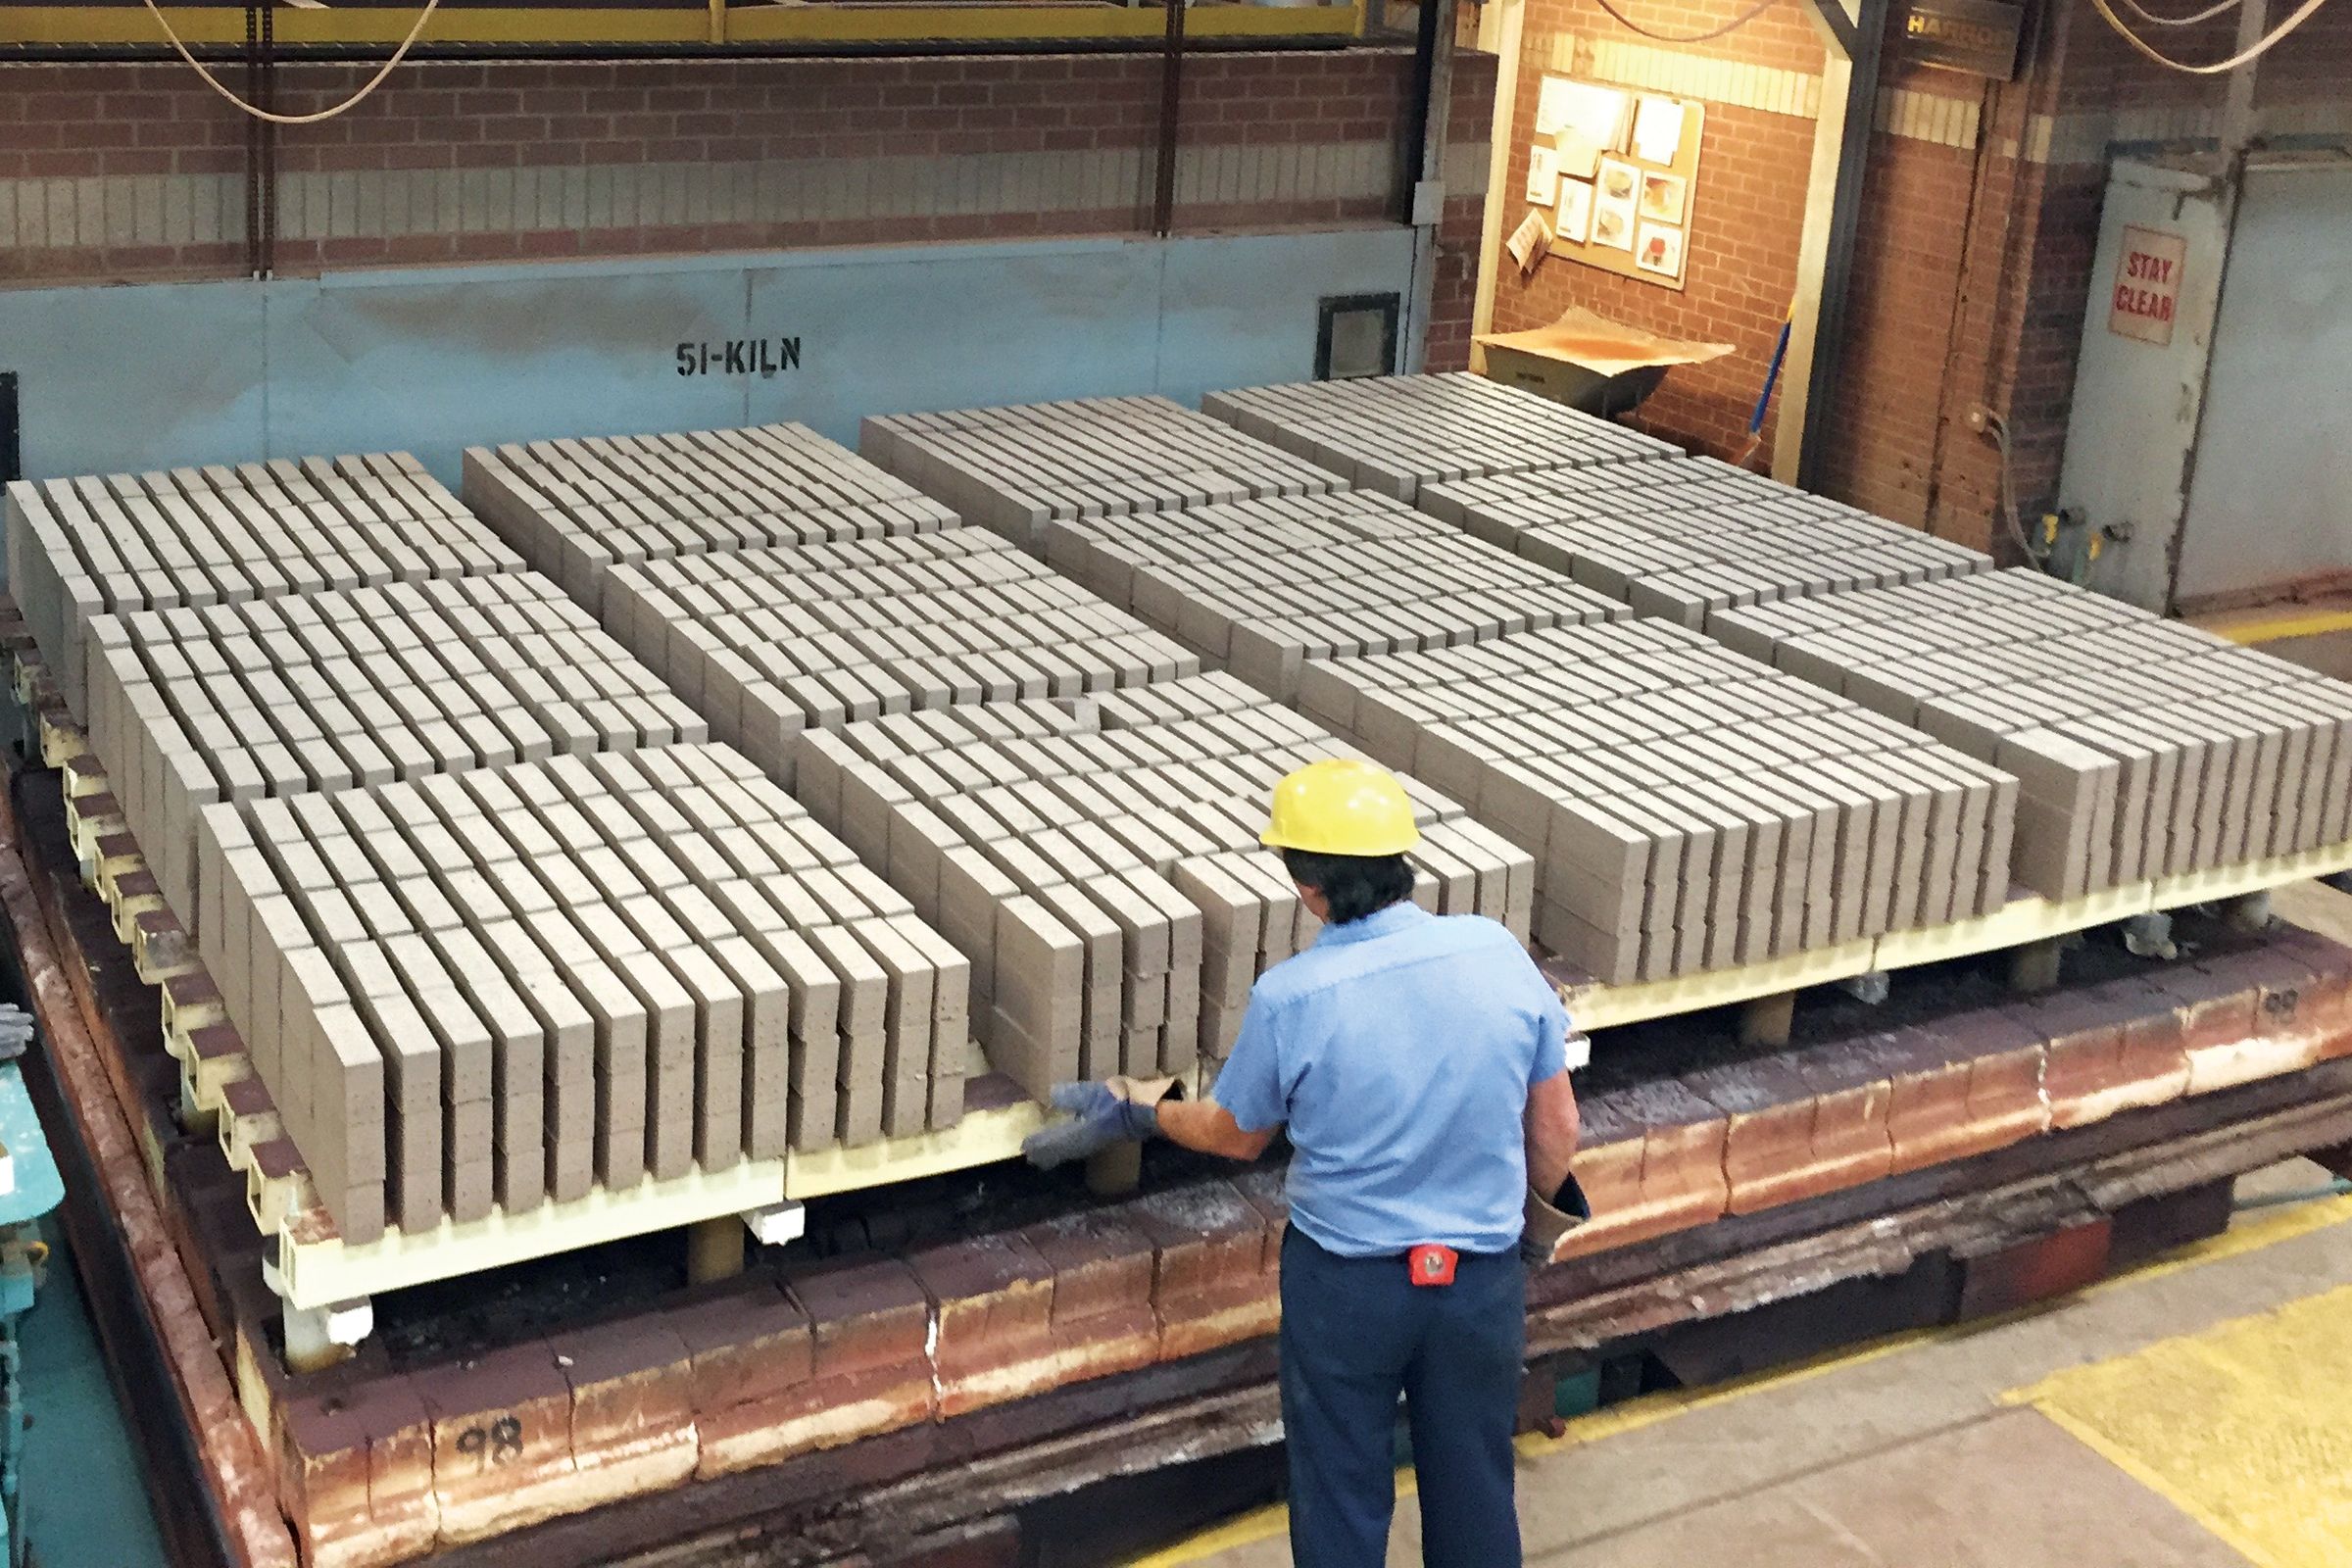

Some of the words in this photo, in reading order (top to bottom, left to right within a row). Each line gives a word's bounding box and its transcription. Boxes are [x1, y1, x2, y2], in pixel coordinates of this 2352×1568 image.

[2127, 251, 2173, 284] STAY
[2116, 284, 2172, 321] CLEAR
[676, 336, 801, 376] 51-KILN
[455, 1415, 523, 1471] 98
